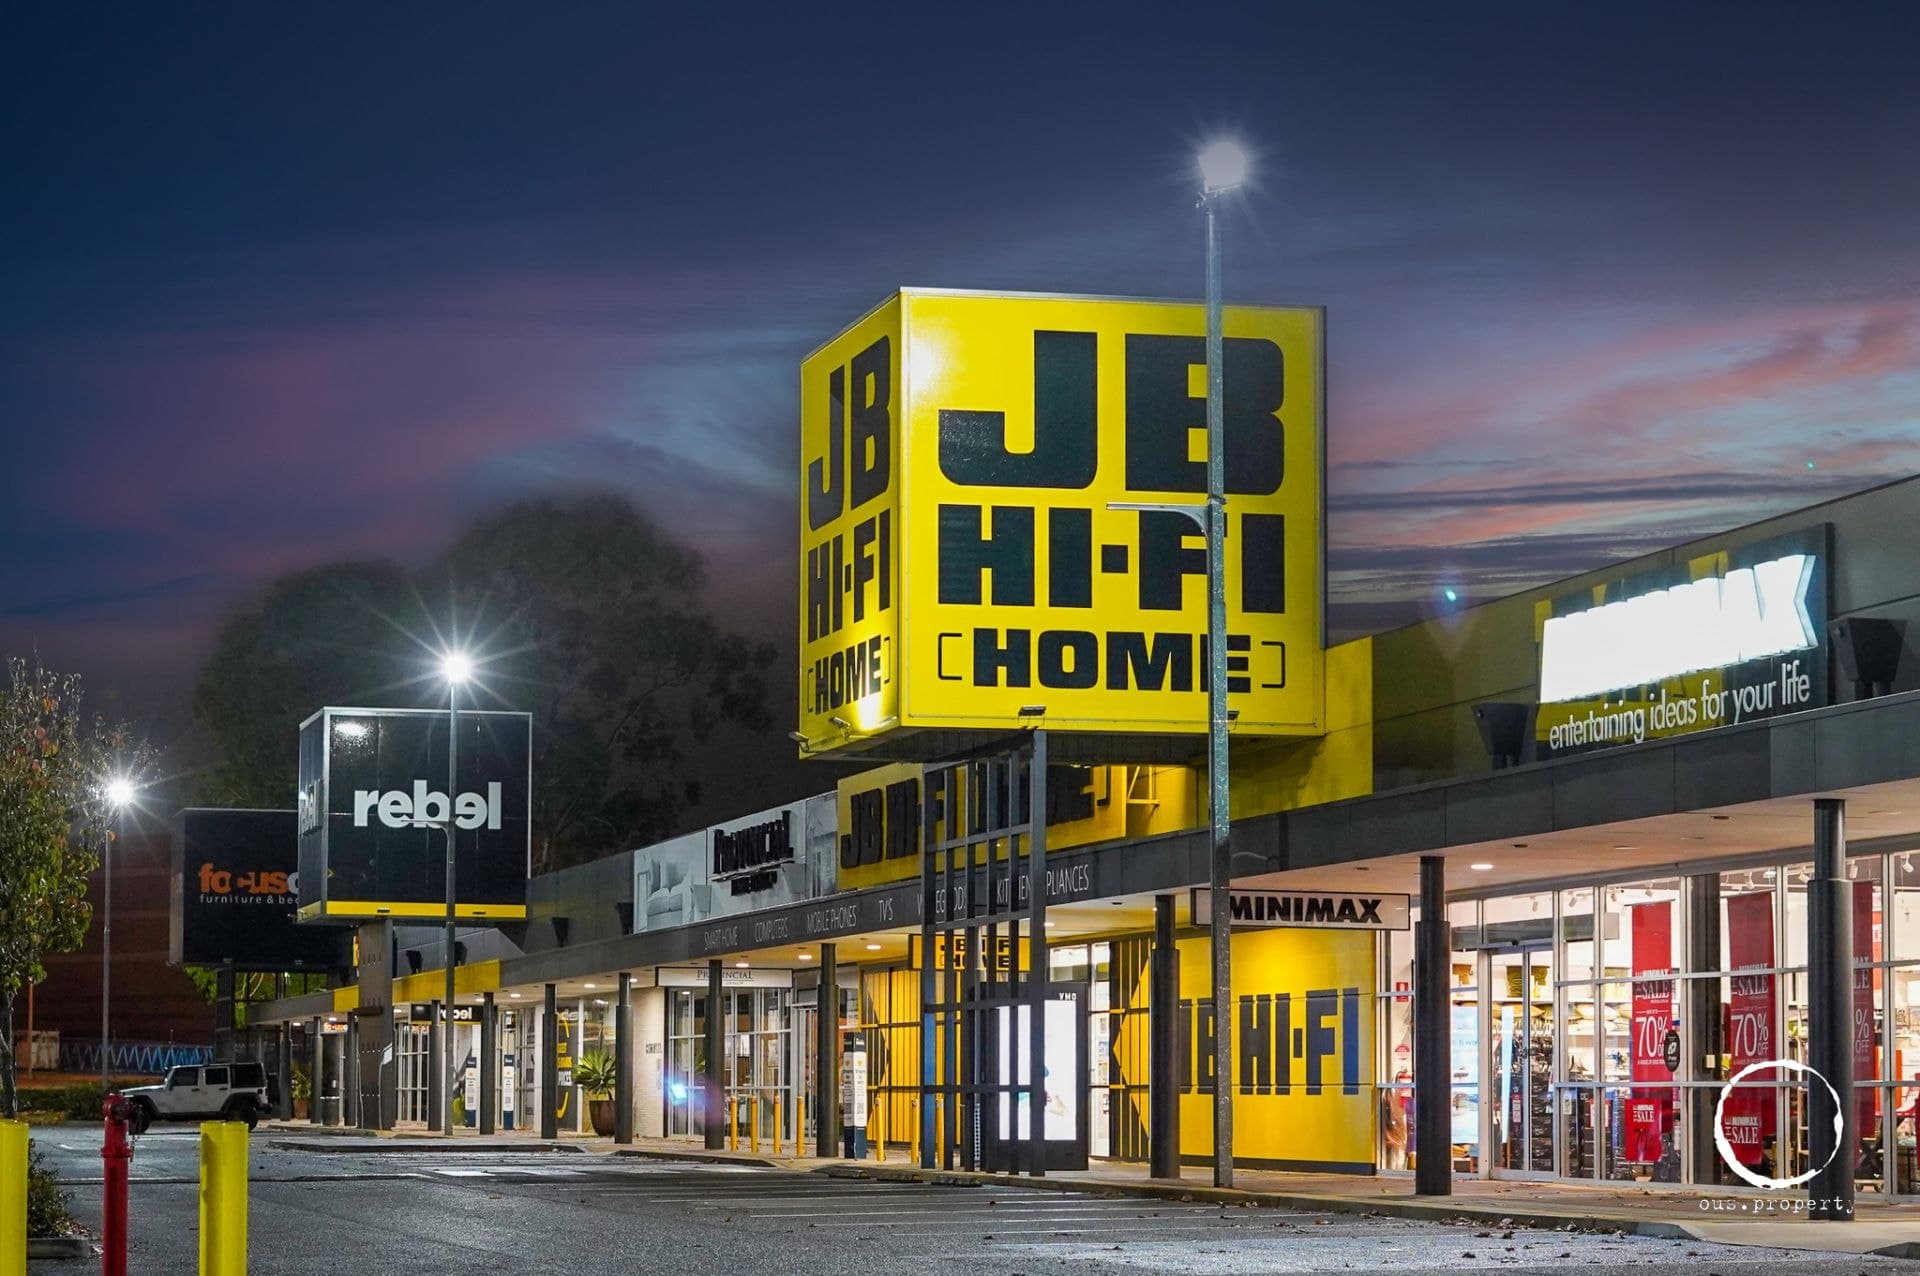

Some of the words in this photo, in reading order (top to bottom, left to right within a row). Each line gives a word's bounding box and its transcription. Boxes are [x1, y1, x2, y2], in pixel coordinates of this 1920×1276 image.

[938, 329, 1285, 496] JB
[808, 334, 890, 531] JB
[808, 508, 890, 644] HI-FI
[938, 504, 1285, 614] HI-FI
[1550, 699, 1645, 750] entertaining
[1650, 689, 1697, 731] ideas
[1700, 679, 1728, 720] for
[1734, 680, 1777, 724] your
[1781, 660, 1811, 705] life
[353, 779, 502, 830] rebel
[841, 788, 883, 869] JB
[200, 893, 262, 905] furniture
[266, 895, 274, 905] &
[1230, 896, 1383, 924] MINIMAX
[755, 917, 791, 943] COMPUTERS
[807, 908, 830, 936] MOBILE
[831, 904, 857, 930] PHONES
[704, 928, 721, 951] SMART
[1738, 974, 1769, 996] SALE
[1239, 987, 1359, 1096] HI-FI
[1730, 1013, 1769, 1057] 70%
[1757, 1042, 1769, 1056] OFF
[1637, 1111, 1655, 1123] SALE
[1732, 1126, 1759, 1144] SALE
